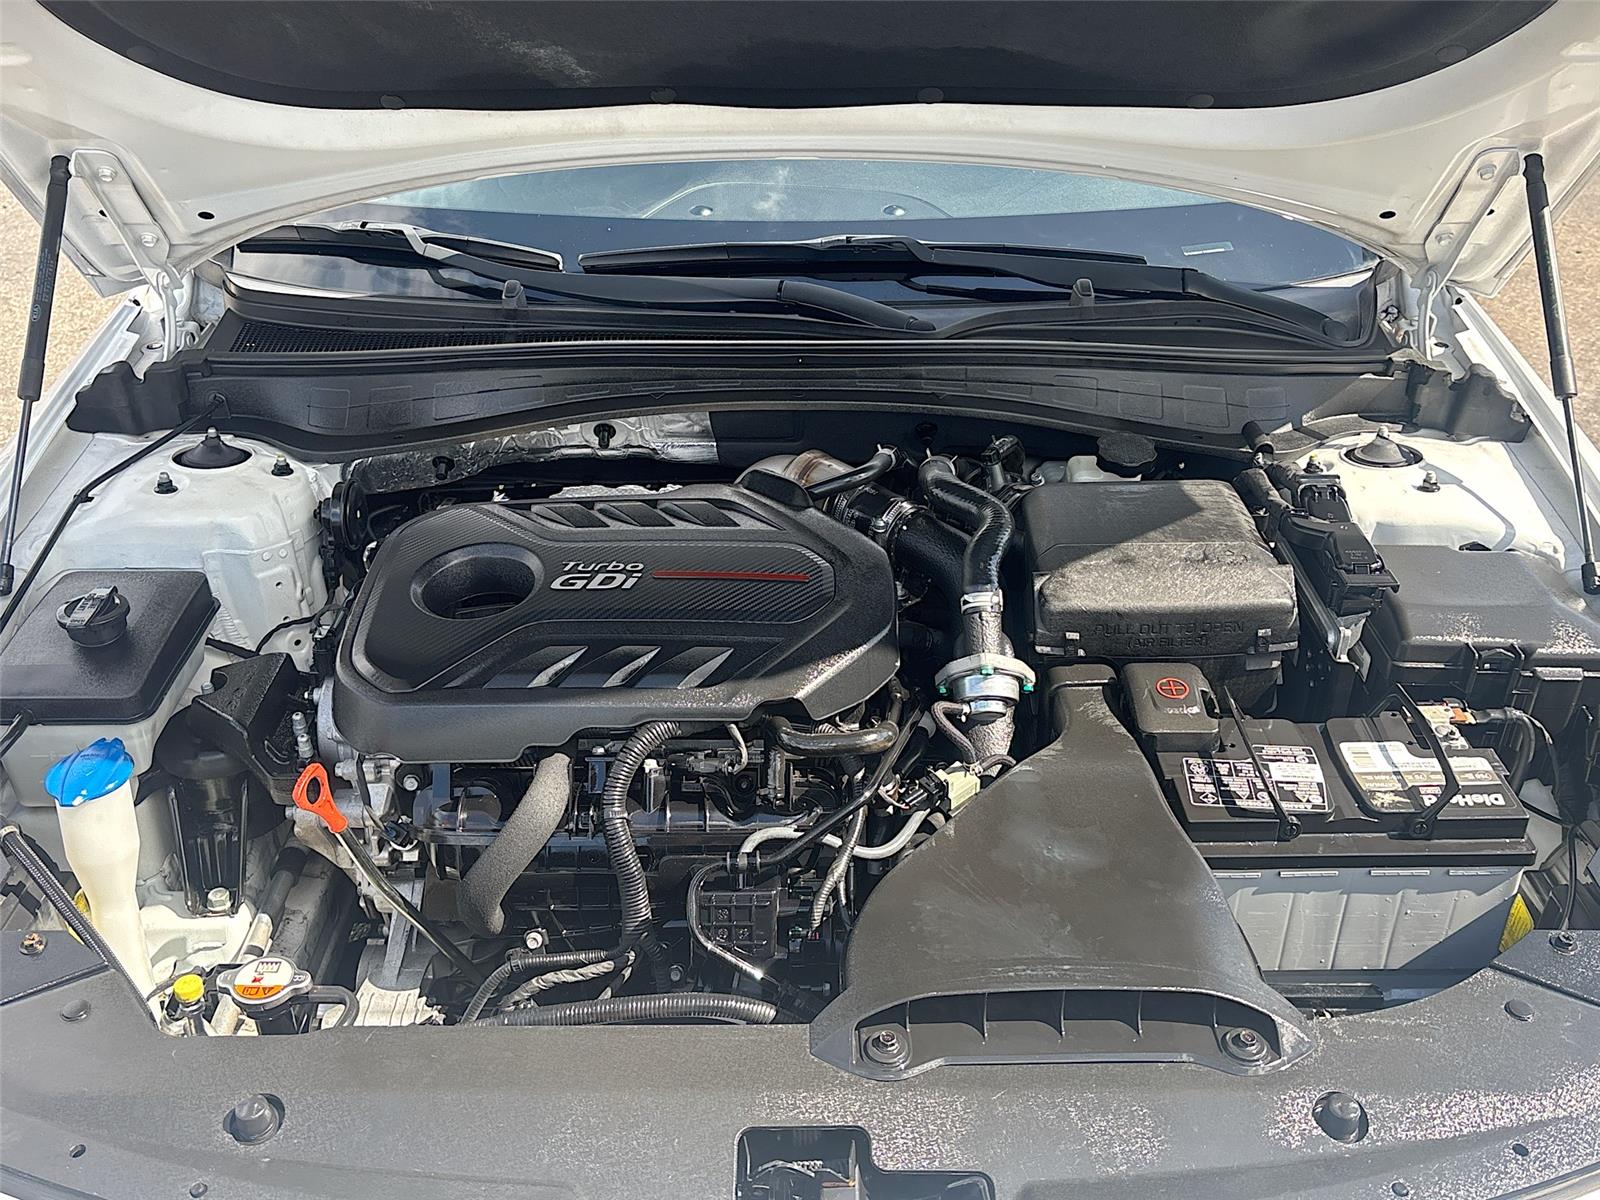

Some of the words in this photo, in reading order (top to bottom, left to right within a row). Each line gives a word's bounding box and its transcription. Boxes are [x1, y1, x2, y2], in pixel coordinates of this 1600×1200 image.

[562, 561, 645, 571] Turbo
[550, 573, 643, 590] GDi
[1094, 623, 1135, 637] PULL
[1139, 623, 1172, 636] OUT
[1175, 622, 1197, 635] TO
[1201, 621, 1245, 634] OPEN
[1419, 793, 1506, 808] DieHd
